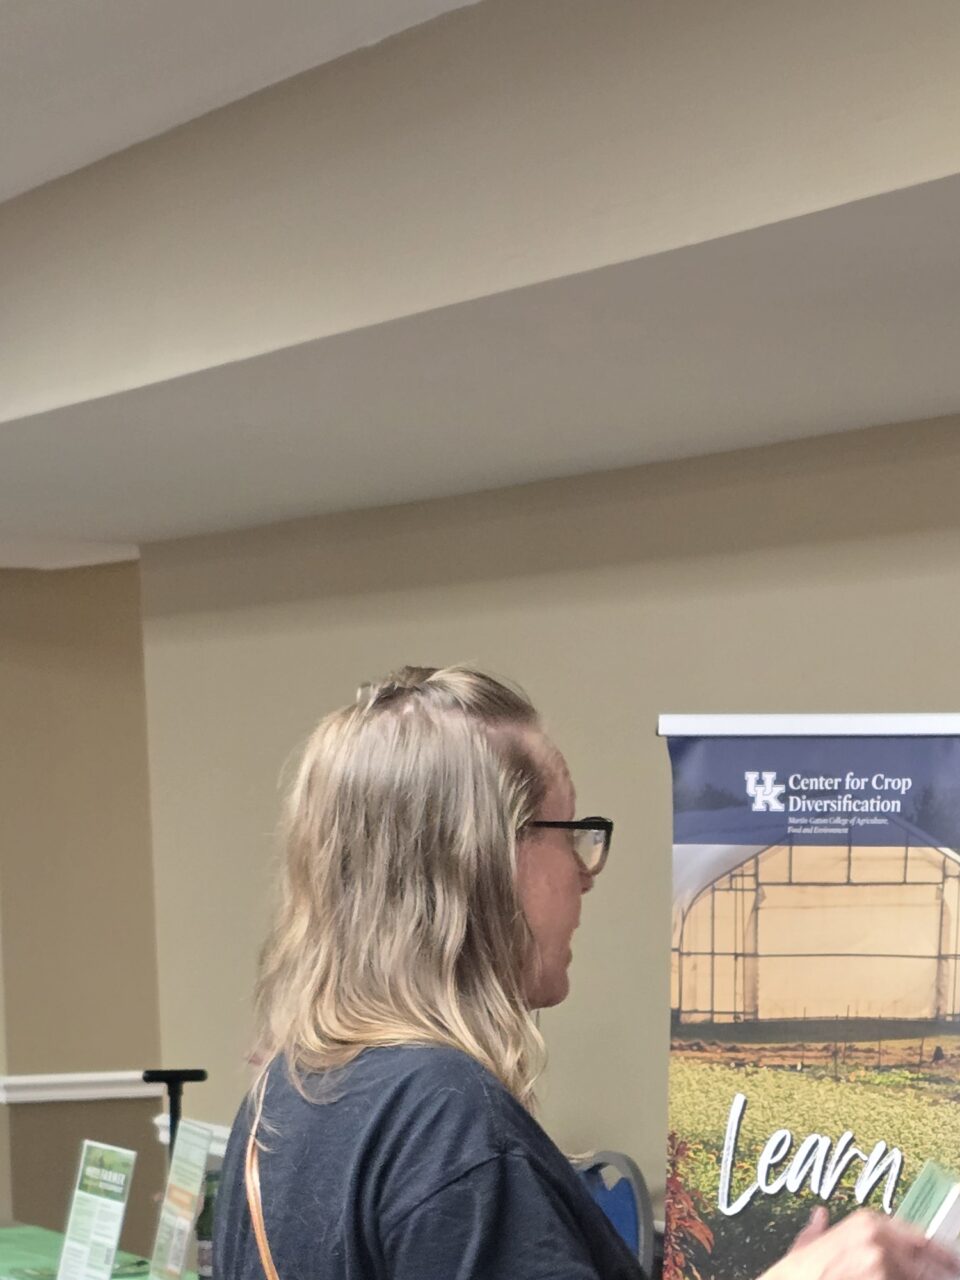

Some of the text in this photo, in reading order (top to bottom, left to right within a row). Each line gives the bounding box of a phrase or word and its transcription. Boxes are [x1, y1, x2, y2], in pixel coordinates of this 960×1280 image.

[788, 771, 912, 795] Center for Crop
[788, 793, 901, 812] Diversification
[718, 1092, 903, 1216] Learn
